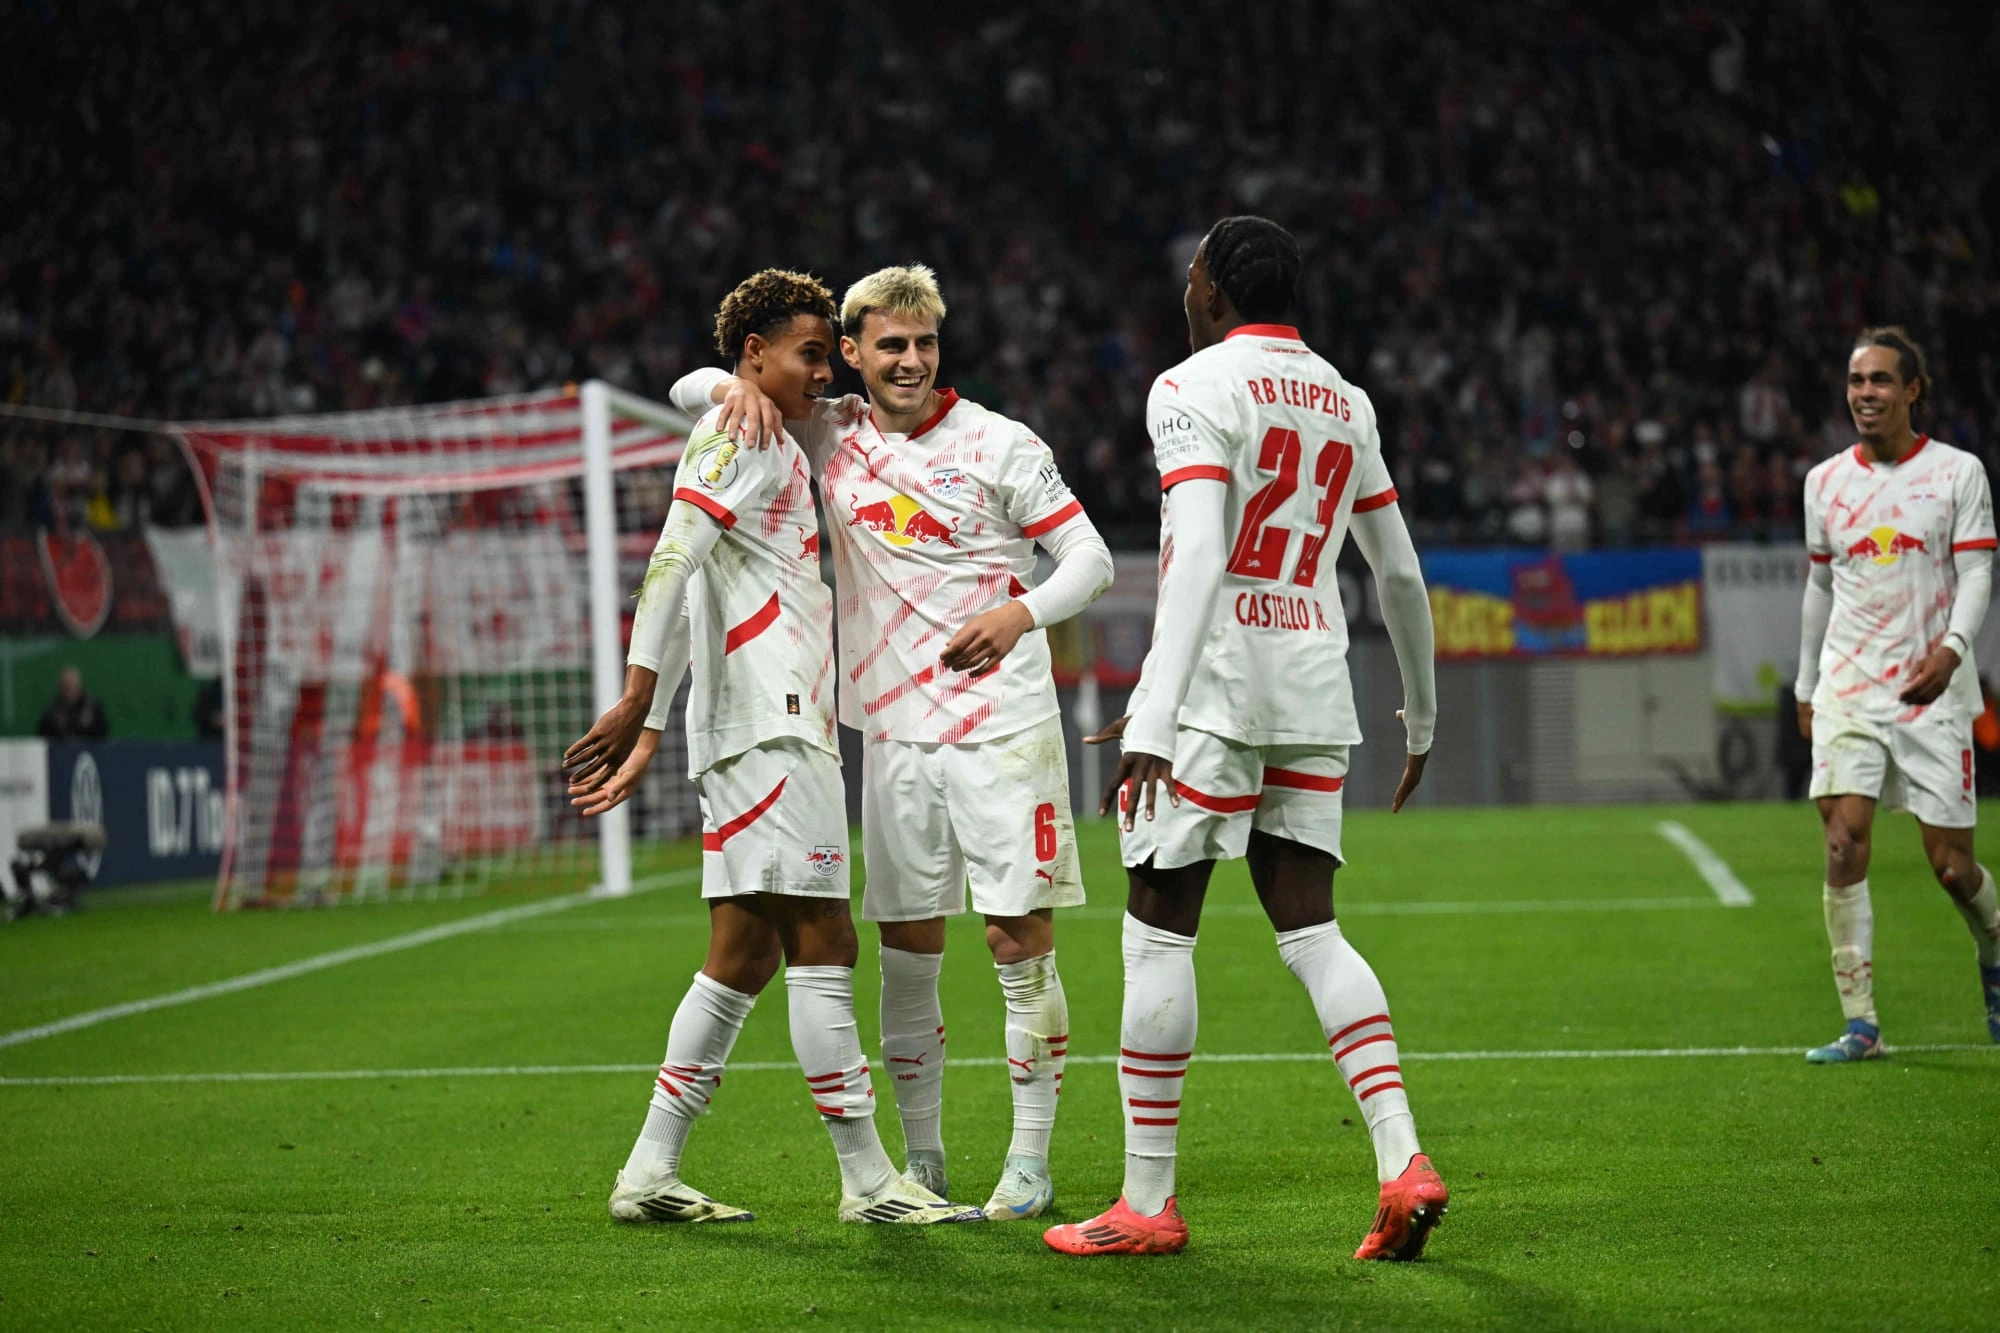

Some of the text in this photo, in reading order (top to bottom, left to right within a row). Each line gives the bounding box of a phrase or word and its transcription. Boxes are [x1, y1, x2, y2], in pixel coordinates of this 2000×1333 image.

[1247, 378, 1351, 422] RB LEIPZIG
[1157, 415, 1191, 438] IHG
[1040, 463, 1058, 484] IH
[1226, 426, 1353, 588] 23
[1235, 592, 1310, 631] CASTELLO
[1034, 802, 1057, 862] 6
